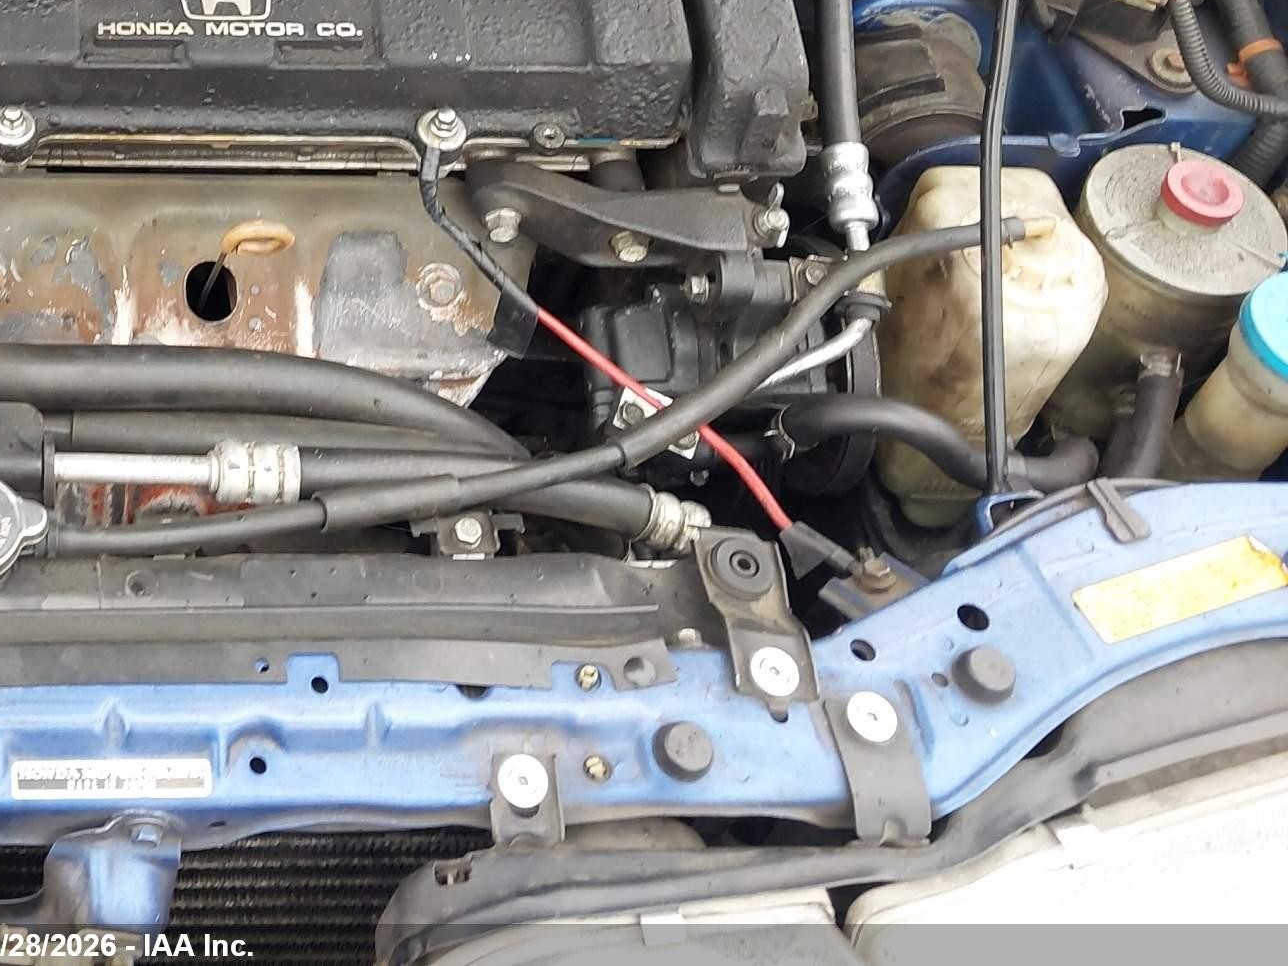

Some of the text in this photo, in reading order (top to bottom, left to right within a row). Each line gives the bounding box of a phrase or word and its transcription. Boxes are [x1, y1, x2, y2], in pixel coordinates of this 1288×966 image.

[97, 21, 363, 37] HONDA MOTOR CO.
